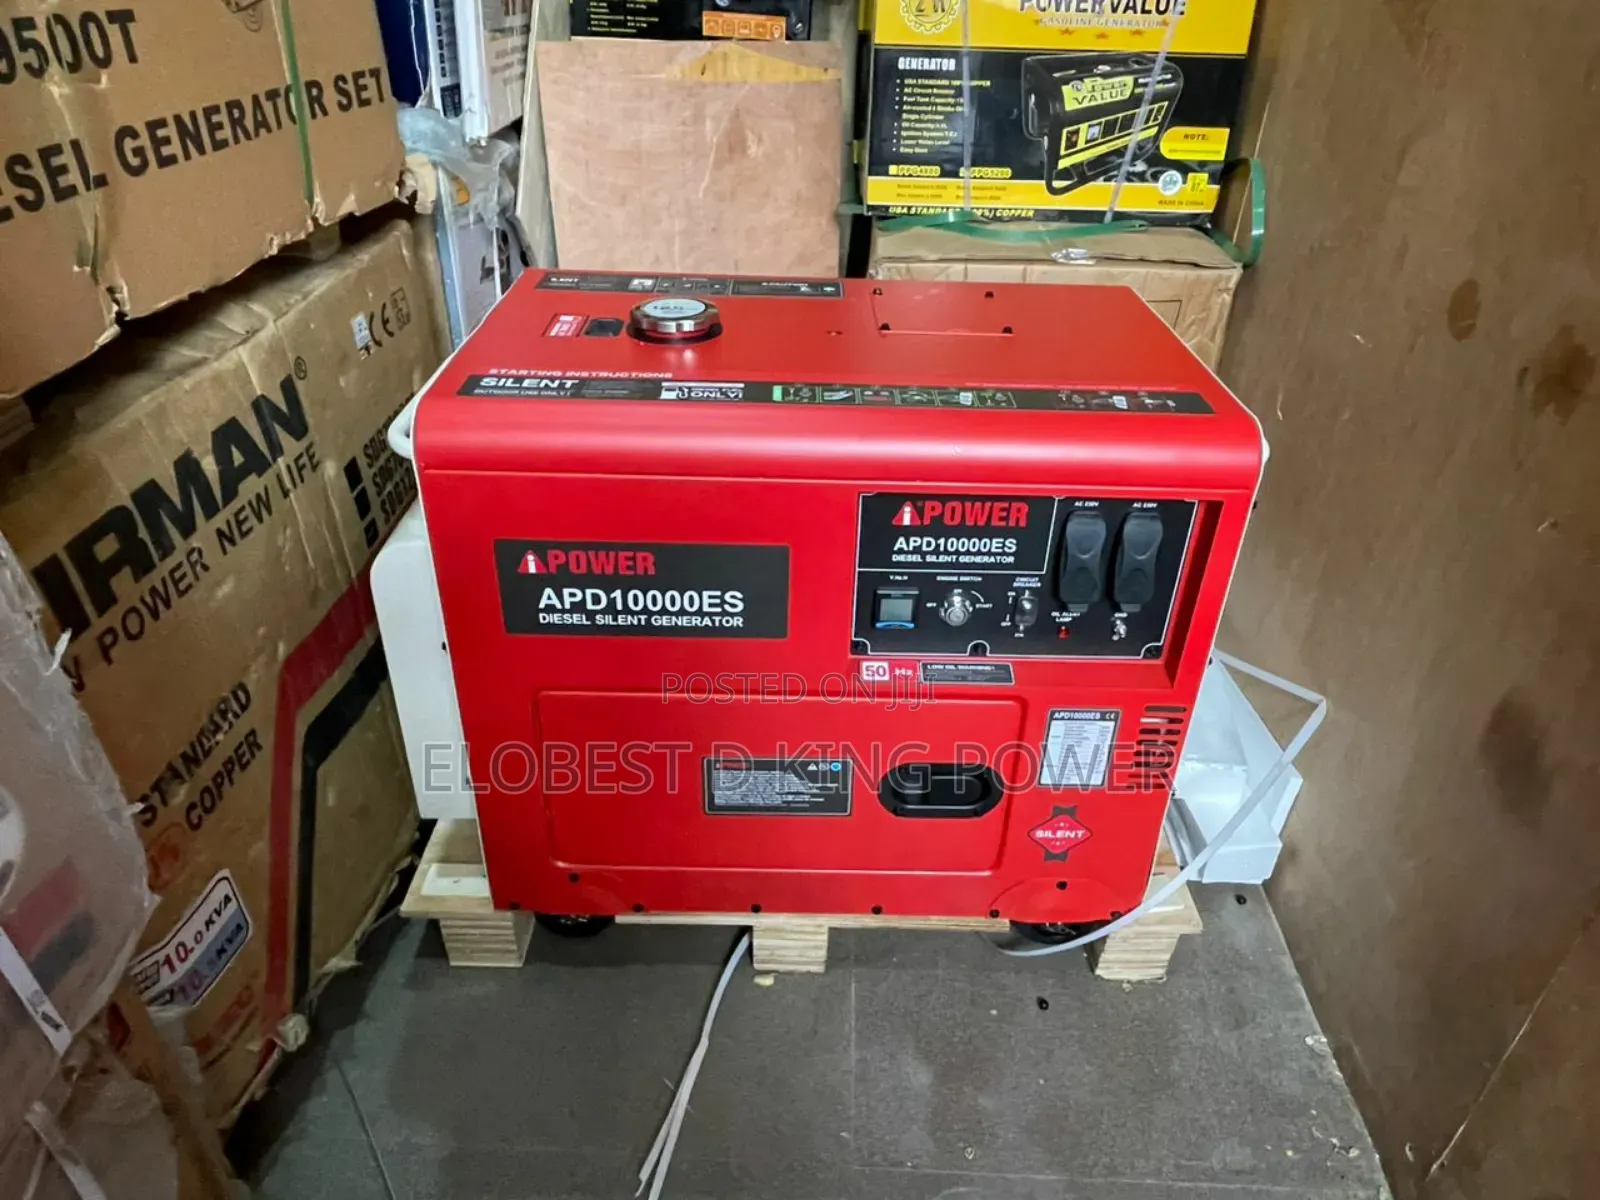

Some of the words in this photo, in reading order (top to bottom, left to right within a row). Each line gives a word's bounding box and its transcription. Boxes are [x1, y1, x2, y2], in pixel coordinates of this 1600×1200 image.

[898, 57, 956, 71] GENERATOR
[333, 67, 386, 113] SET
[1073, 90, 1128, 105] VALUE
[888, 206, 908, 214] USA
[996, 209, 1035, 218] COPPER
[489, 369, 563, 377] STARTING
[564, 370, 673, 379] INSTRUCTIONS
[479, 377, 580, 389] SILENT
[32, 373, 310, 642] IRMAN
[893, 536, 1017, 553] APD10000ES
[96, 548, 211, 666] POWER
[215, 489, 274, 556] NEW
[279, 442, 322, 501] LIFE
[892, 554, 923, 562] DIESEL
[925, 555, 957, 563] SILENT
[959, 555, 1015, 564] GENERATOR
[538, 587, 744, 613] APD10000ES
[539, 613, 591, 625] DIESEL
[596, 614, 648, 626] SILENT
[651, 615, 744, 628] GENERATOR
[864, 664, 887, 677] 50
[894, 668, 913, 677] Hz
[184, 727, 265, 832] COPPER
[1034, 829, 1086, 838] SILENT
[161, 929, 204, 975] 10.0
[204, 893, 233, 933] KVA
